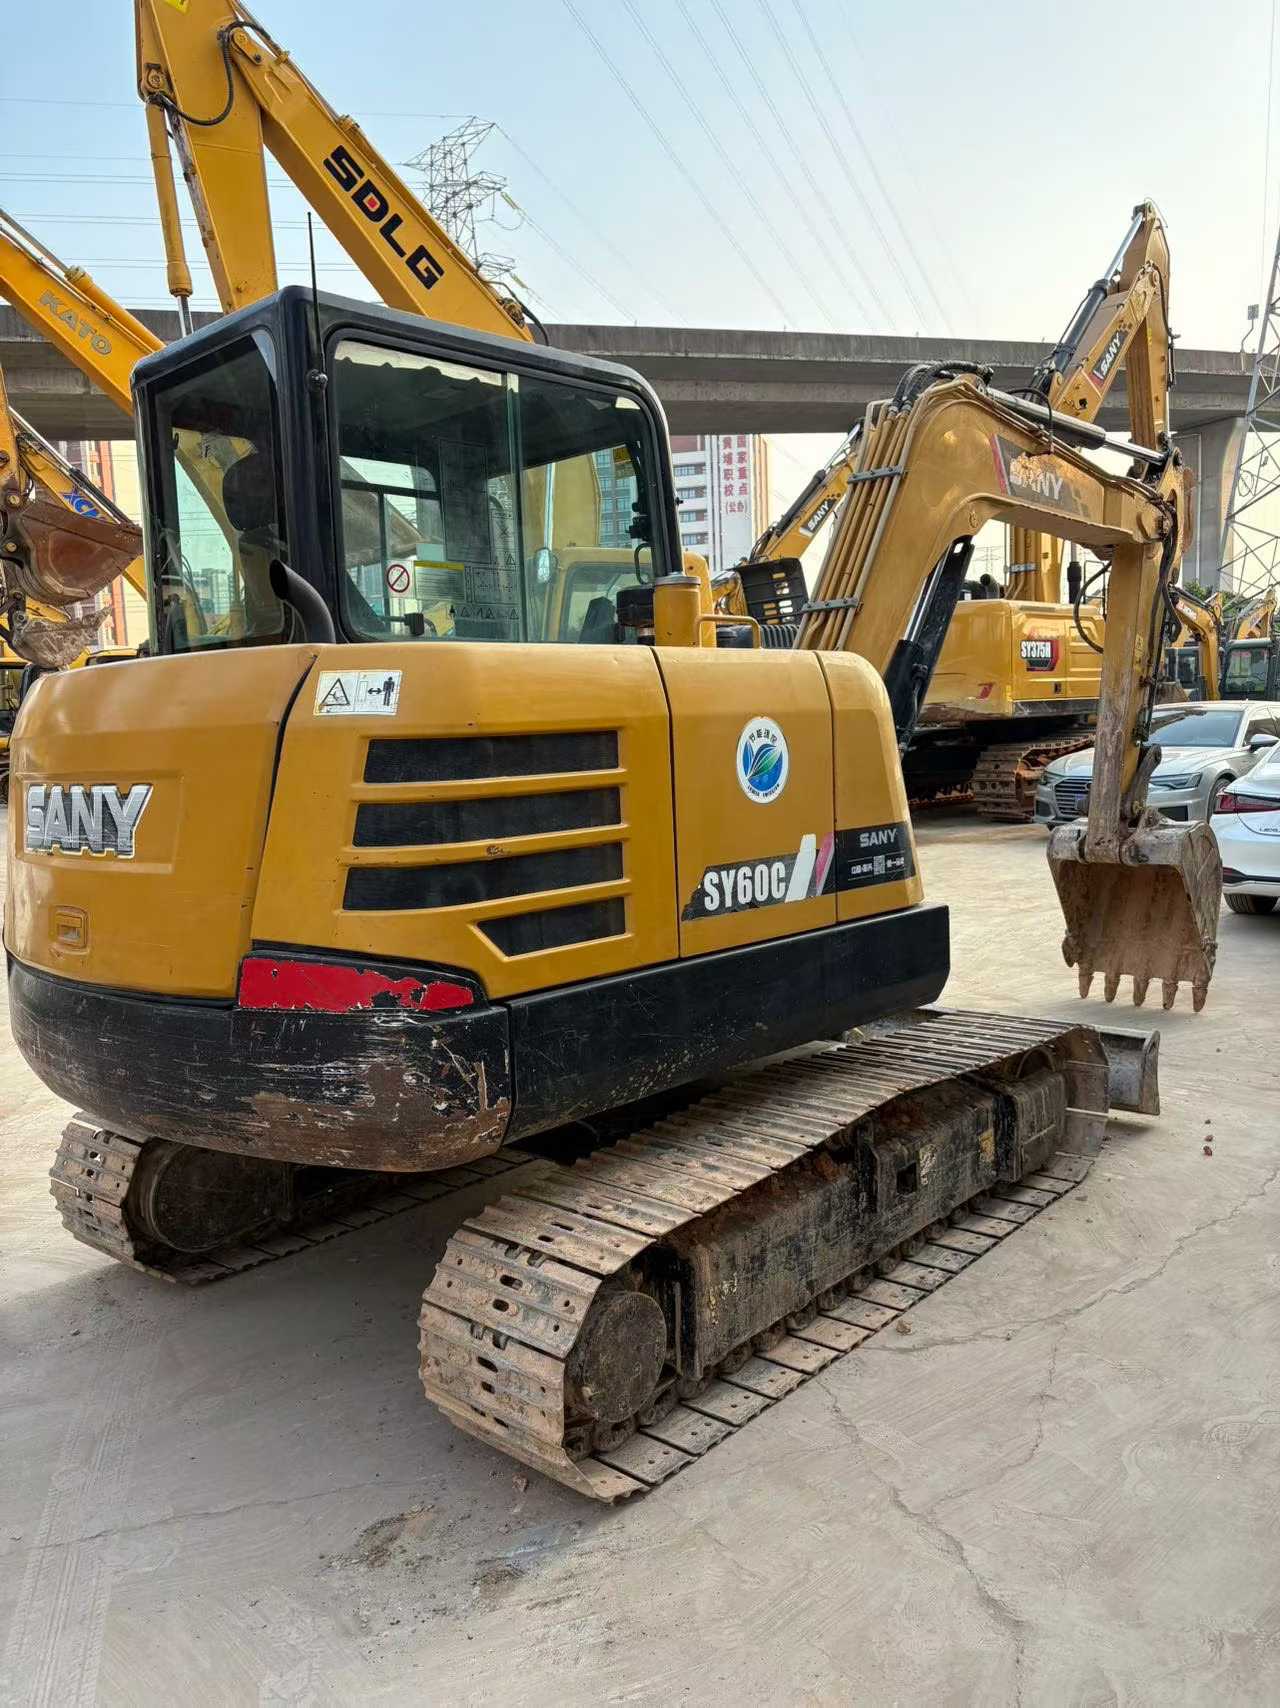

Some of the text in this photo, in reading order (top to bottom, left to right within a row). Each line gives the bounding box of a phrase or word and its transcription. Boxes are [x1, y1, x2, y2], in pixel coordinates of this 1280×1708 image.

[323, 144, 445, 290] SDLG
[38, 289, 113, 355] KATO
[1101, 331, 1120, 376] SANY
[807, 500, 829, 531] SANY
[27, 783, 153, 858] SANY
[860, 828, 897, 848] SANY
[703, 861, 786, 911] SY60C
